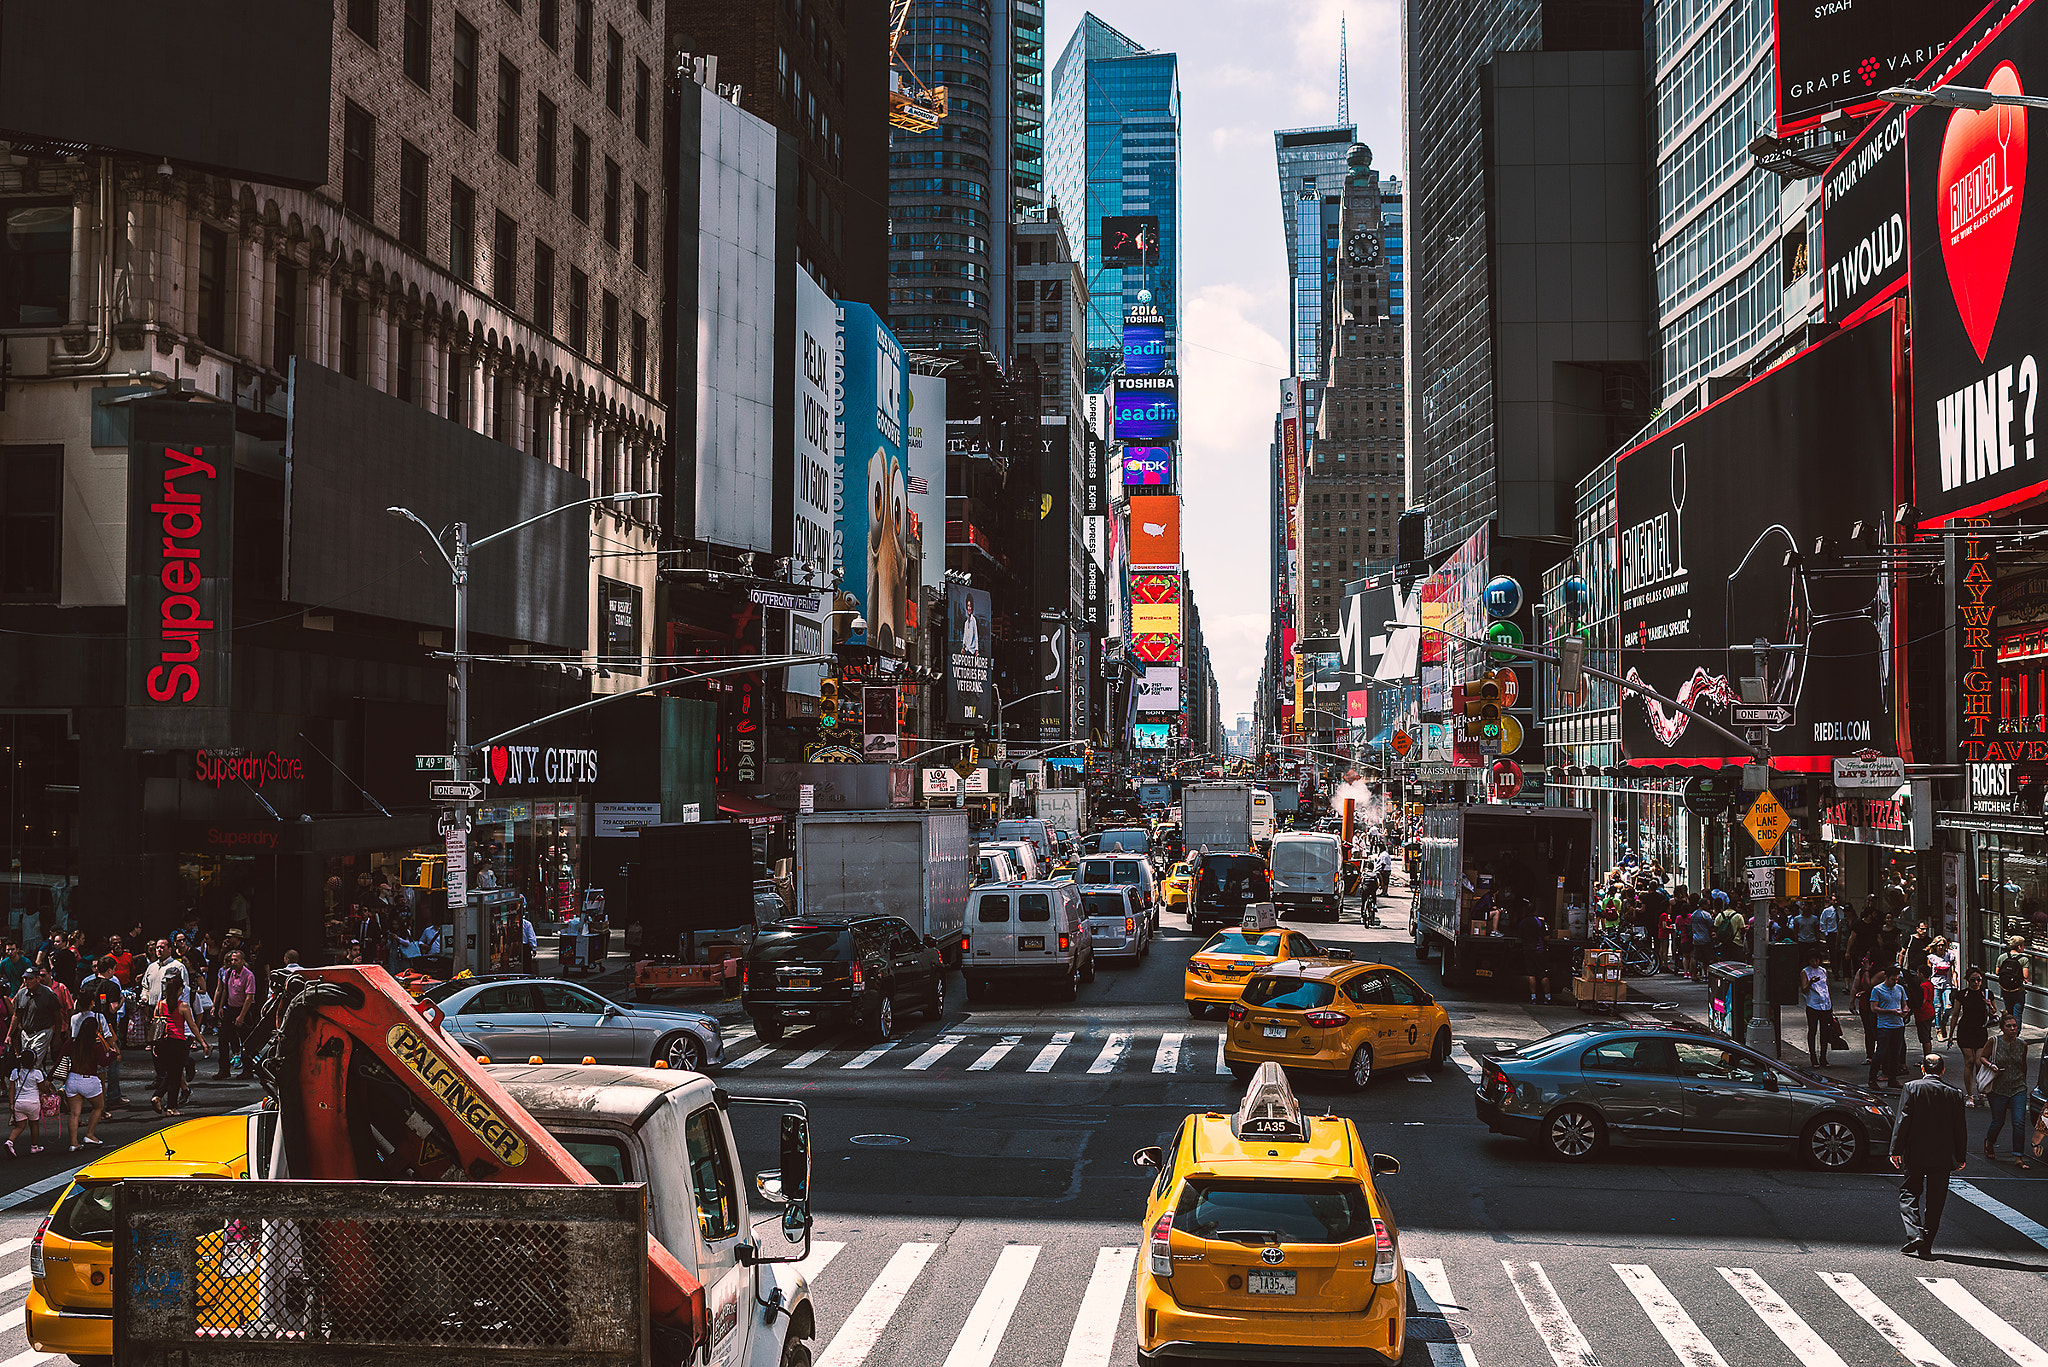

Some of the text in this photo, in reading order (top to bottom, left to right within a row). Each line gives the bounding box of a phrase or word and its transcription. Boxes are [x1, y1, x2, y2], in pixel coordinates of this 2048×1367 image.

[1814, 0, 1852, 19] SYRAH
[1791, 41, 1951, 98] GRAPE VARIE
[1824, 107, 1909, 211] IF YOUR WINE COU
[1950, 153, 1998, 234] RIEDEL
[1951, 194, 2013, 246] THE WINE GLASS COMPANY
[1827, 212, 1904, 313] IT WOULD
[1124, 316, 1165, 324] TOSHIBA
[803, 330, 829, 403] RELAX,
[888, 337, 900, 367] YOUR
[877, 345, 901, 428] ICE
[1118, 378, 1175, 389] TOSHIBA
[802, 391, 828, 456] YOU'RE
[877, 409, 900, 448] GOODBYE
[1089, 395, 1097, 433] EXPRESS
[1937, 354, 2039, 492] WINE?
[1088, 441, 1097, 479] EXPRESS
[1138, 460, 1167, 471] TDK
[800, 452, 828, 515] IN GOOD
[795, 513, 831, 575] COMPANY
[833, 529, 844, 566] ISS
[1089, 517, 1097, 554] EXPRESS
[1622, 512, 1673, 594] RIEDEL
[147, 446, 218, 703] Superdry.
[1088, 562, 1097, 601] EXPRESS
[753, 592, 819, 611] OUTFRONT PRIME
[1491, 590, 1506, 604] m
[1632, 594, 1645, 608] WINE
[1645, 590, 1662, 604] GLASS
[1662, 581, 1689, 599] COMPANY
[1624, 619, 1690, 648] GRAPE VARIETAL SPECIFIC
[1961, 518, 1996, 737] PLAYWRIGHT
[952, 653, 988, 669] SUPPORT MORE
[952, 666, 988, 681] VICTORIES FOR
[957, 680, 984, 693] VETERANS.
[1077, 640, 1085, 726] PALACE
[1505, 681, 1516, 695] m
[1740, 711, 1785, 719] ONE WAY
[1814, 720, 1871, 742] RIEDEL.COM
[417, 758, 424, 768] W
[425, 758, 435, 768] 49
[481, 745, 490, 784] I
[544, 747, 598, 784] GIFTS
[738, 739, 755, 782] BAR
[1961, 741, 2048, 761] TAVE
[1299, 766, 1310, 789] tkts
[1500, 773, 1515, 785] m
[1838, 769, 1900, 778] RAY'S PIZZA
[1972, 763, 2013, 796] ROAST
[438, 786, 477, 795] ONE WAY
[1755, 802, 1778, 814] RIGHT
[1861, 797, 1903, 831] PIZZA
[1978, 800, 2006, 813] KITCHEN
[1756, 816, 1778, 827] LANE
[1757, 829, 1777, 840] ENDS
[208, 828, 280, 849] Superdry.
[1755, 858, 1778, 867] ROUTE
[1749, 880, 1764, 889] NOT
[393, 1030, 520, 1160] PALFINGER
[1256, 1121, 1286, 1131] 1A35
